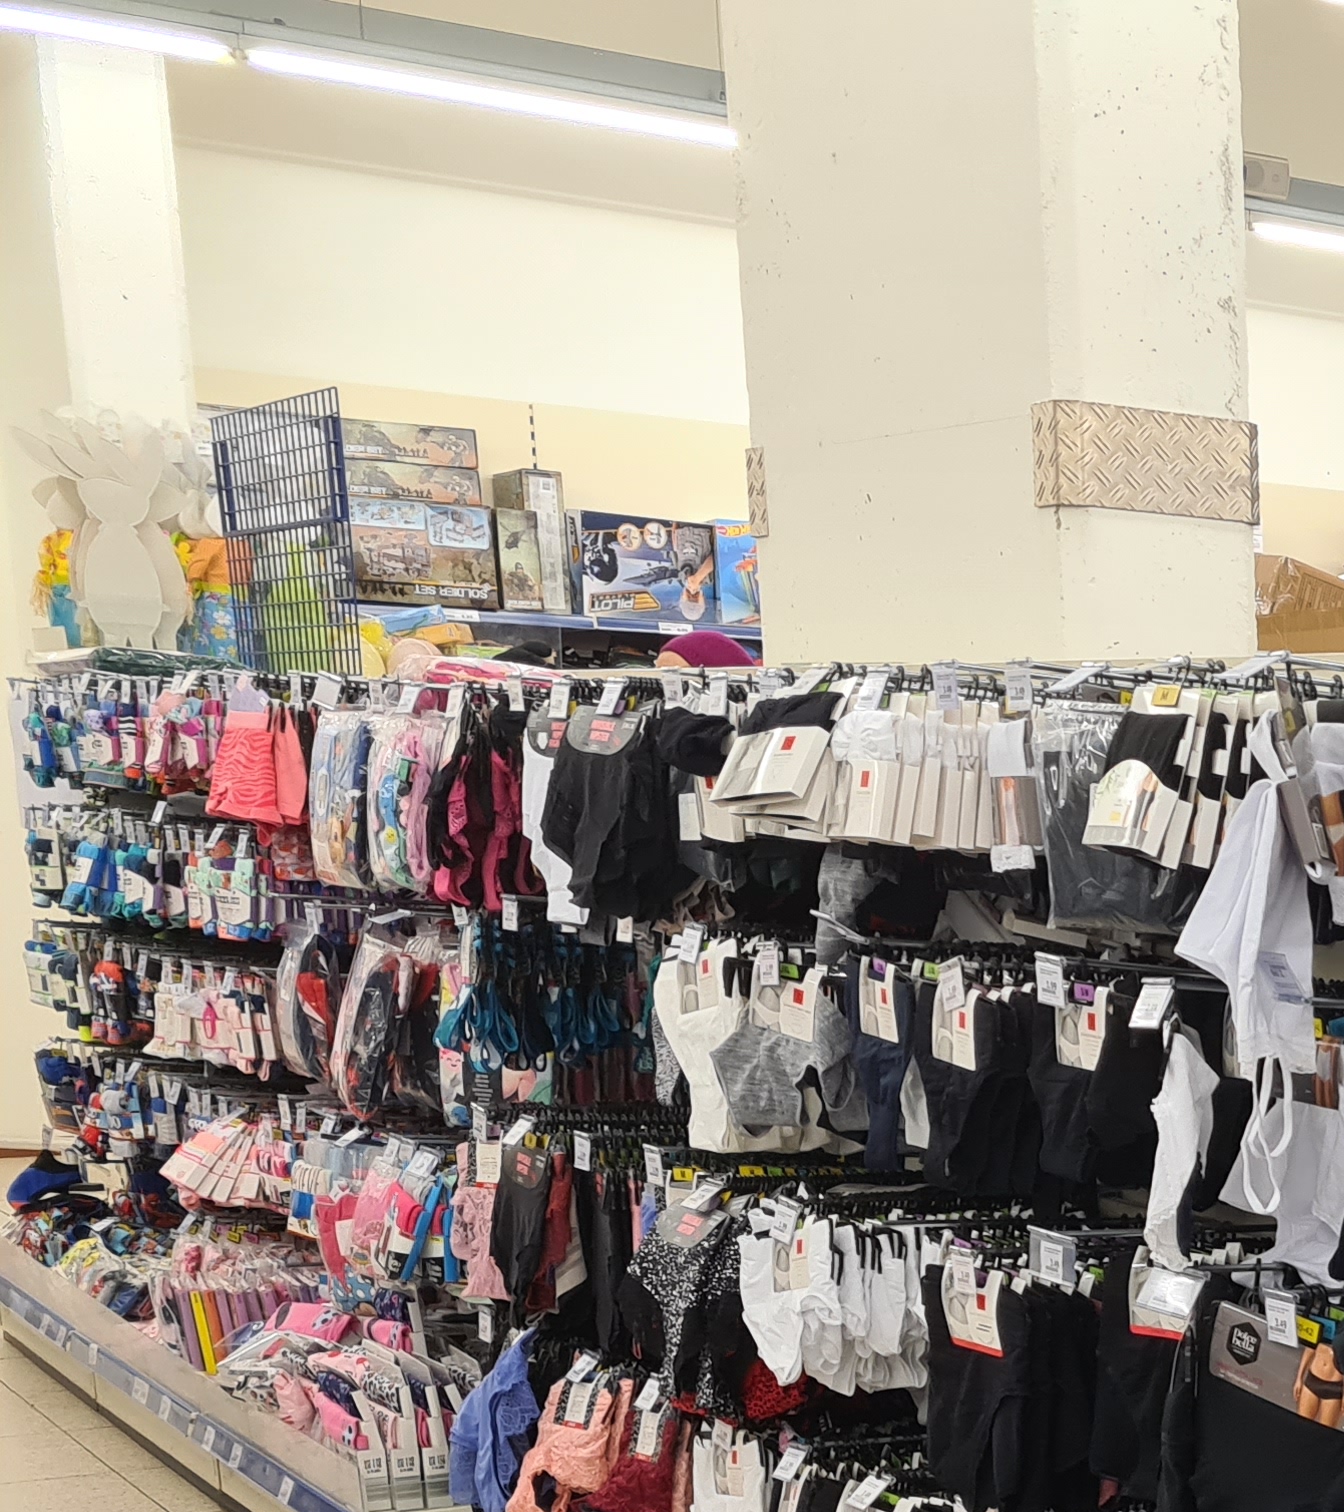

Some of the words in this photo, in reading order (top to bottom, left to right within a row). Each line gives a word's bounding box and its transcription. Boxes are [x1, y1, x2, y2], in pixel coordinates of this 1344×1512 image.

[414, 584, 438, 596] SET
[440, 585, 488, 600] SOLDIER
[591, 597, 634, 610] PILOT
[1232, 1326, 1257, 1343] Dolce
[1232, 1336, 1256, 1352] bella
